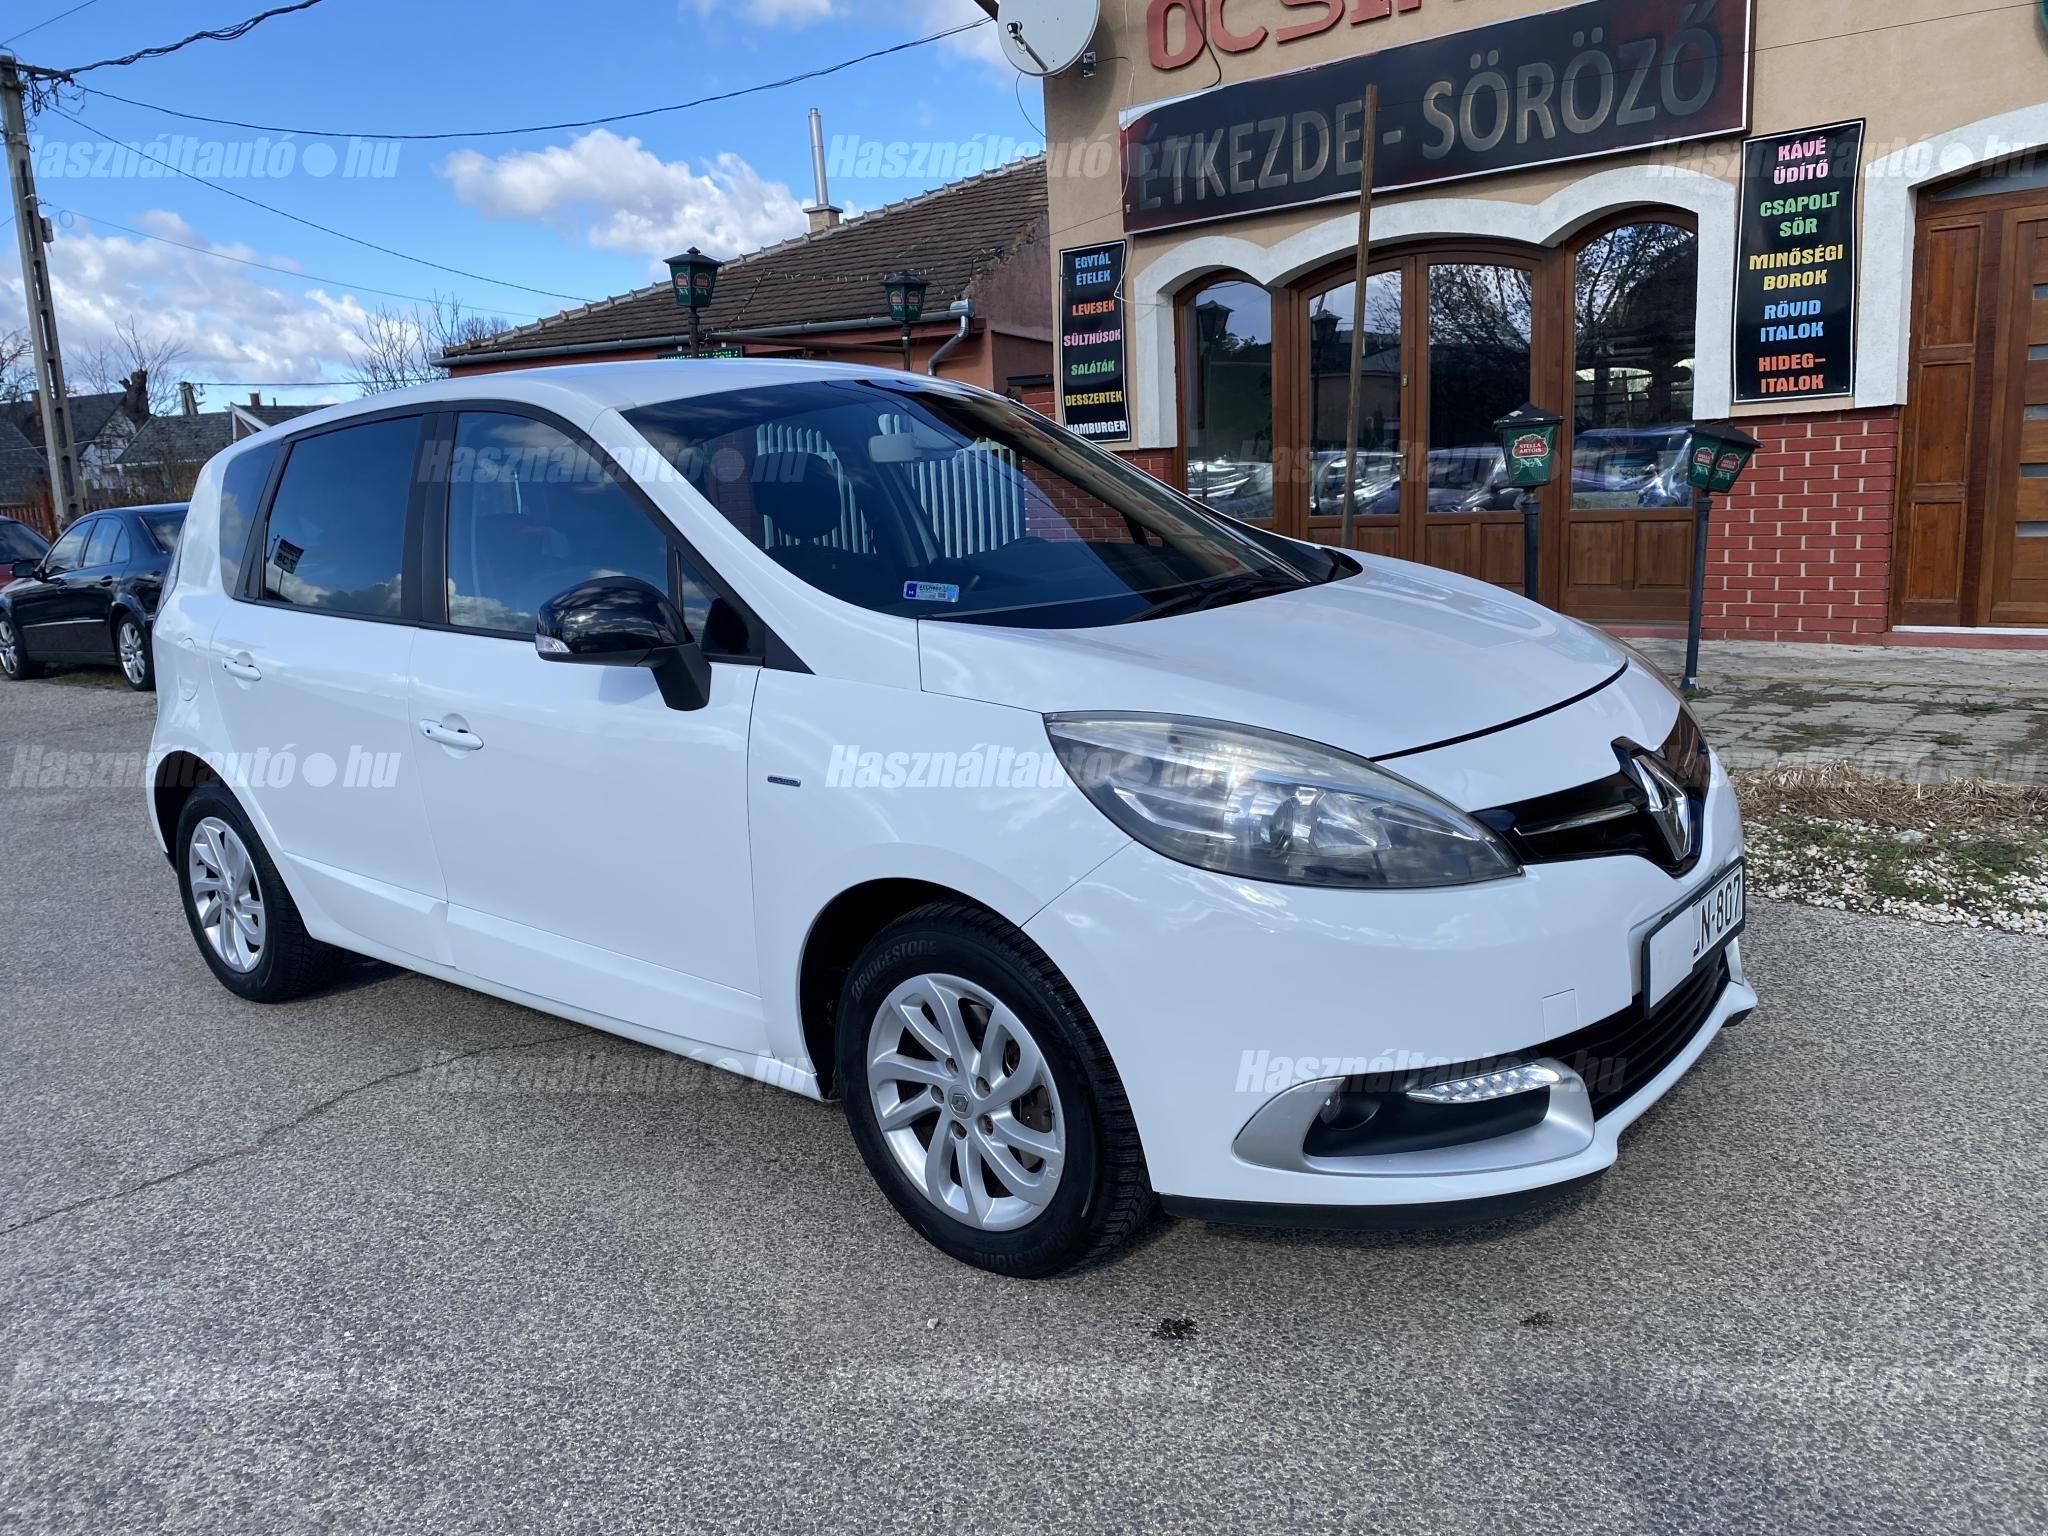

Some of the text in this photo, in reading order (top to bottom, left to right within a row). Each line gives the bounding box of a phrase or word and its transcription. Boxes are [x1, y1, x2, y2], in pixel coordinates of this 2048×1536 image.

[1139, 100, 1363, 210] ÉTKEZDE
[1422, 2, 1717, 159] SÖRÖZŐ
[1778, 136, 1826, 161] KÁVÉ
[1774, 159, 1828, 185] ÜDÍTŐ
[1760, 191, 1840, 217] CSAPOLT
[1780, 217, 1817, 237] SÖR
[1075, 251, 1111, 269] EGYTÁL
[1749, 244, 1843, 270] MINŐSÉGI
[1076, 270, 1110, 285] ÉTELEK
[1763, 269, 1827, 291] BOROK
[1072, 299, 1114, 316] LEVESEK
[1764, 299, 1821, 320] RÖVID
[1063, 329, 1120, 346] SÜLTHÚSOK
[1760, 321, 1823, 342] ITALOK
[1071, 359, 1114, 375] SALÁTÁK
[1761, 374, 1824, 393] ITALOK
[1065, 391, 1122, 406] DESSZERTEK
[1067, 420, 1127, 435] HAMBURGER
[1693, 874, 1740, 957] N-807
[851, 940, 937, 1001] BRIDGESTONE
